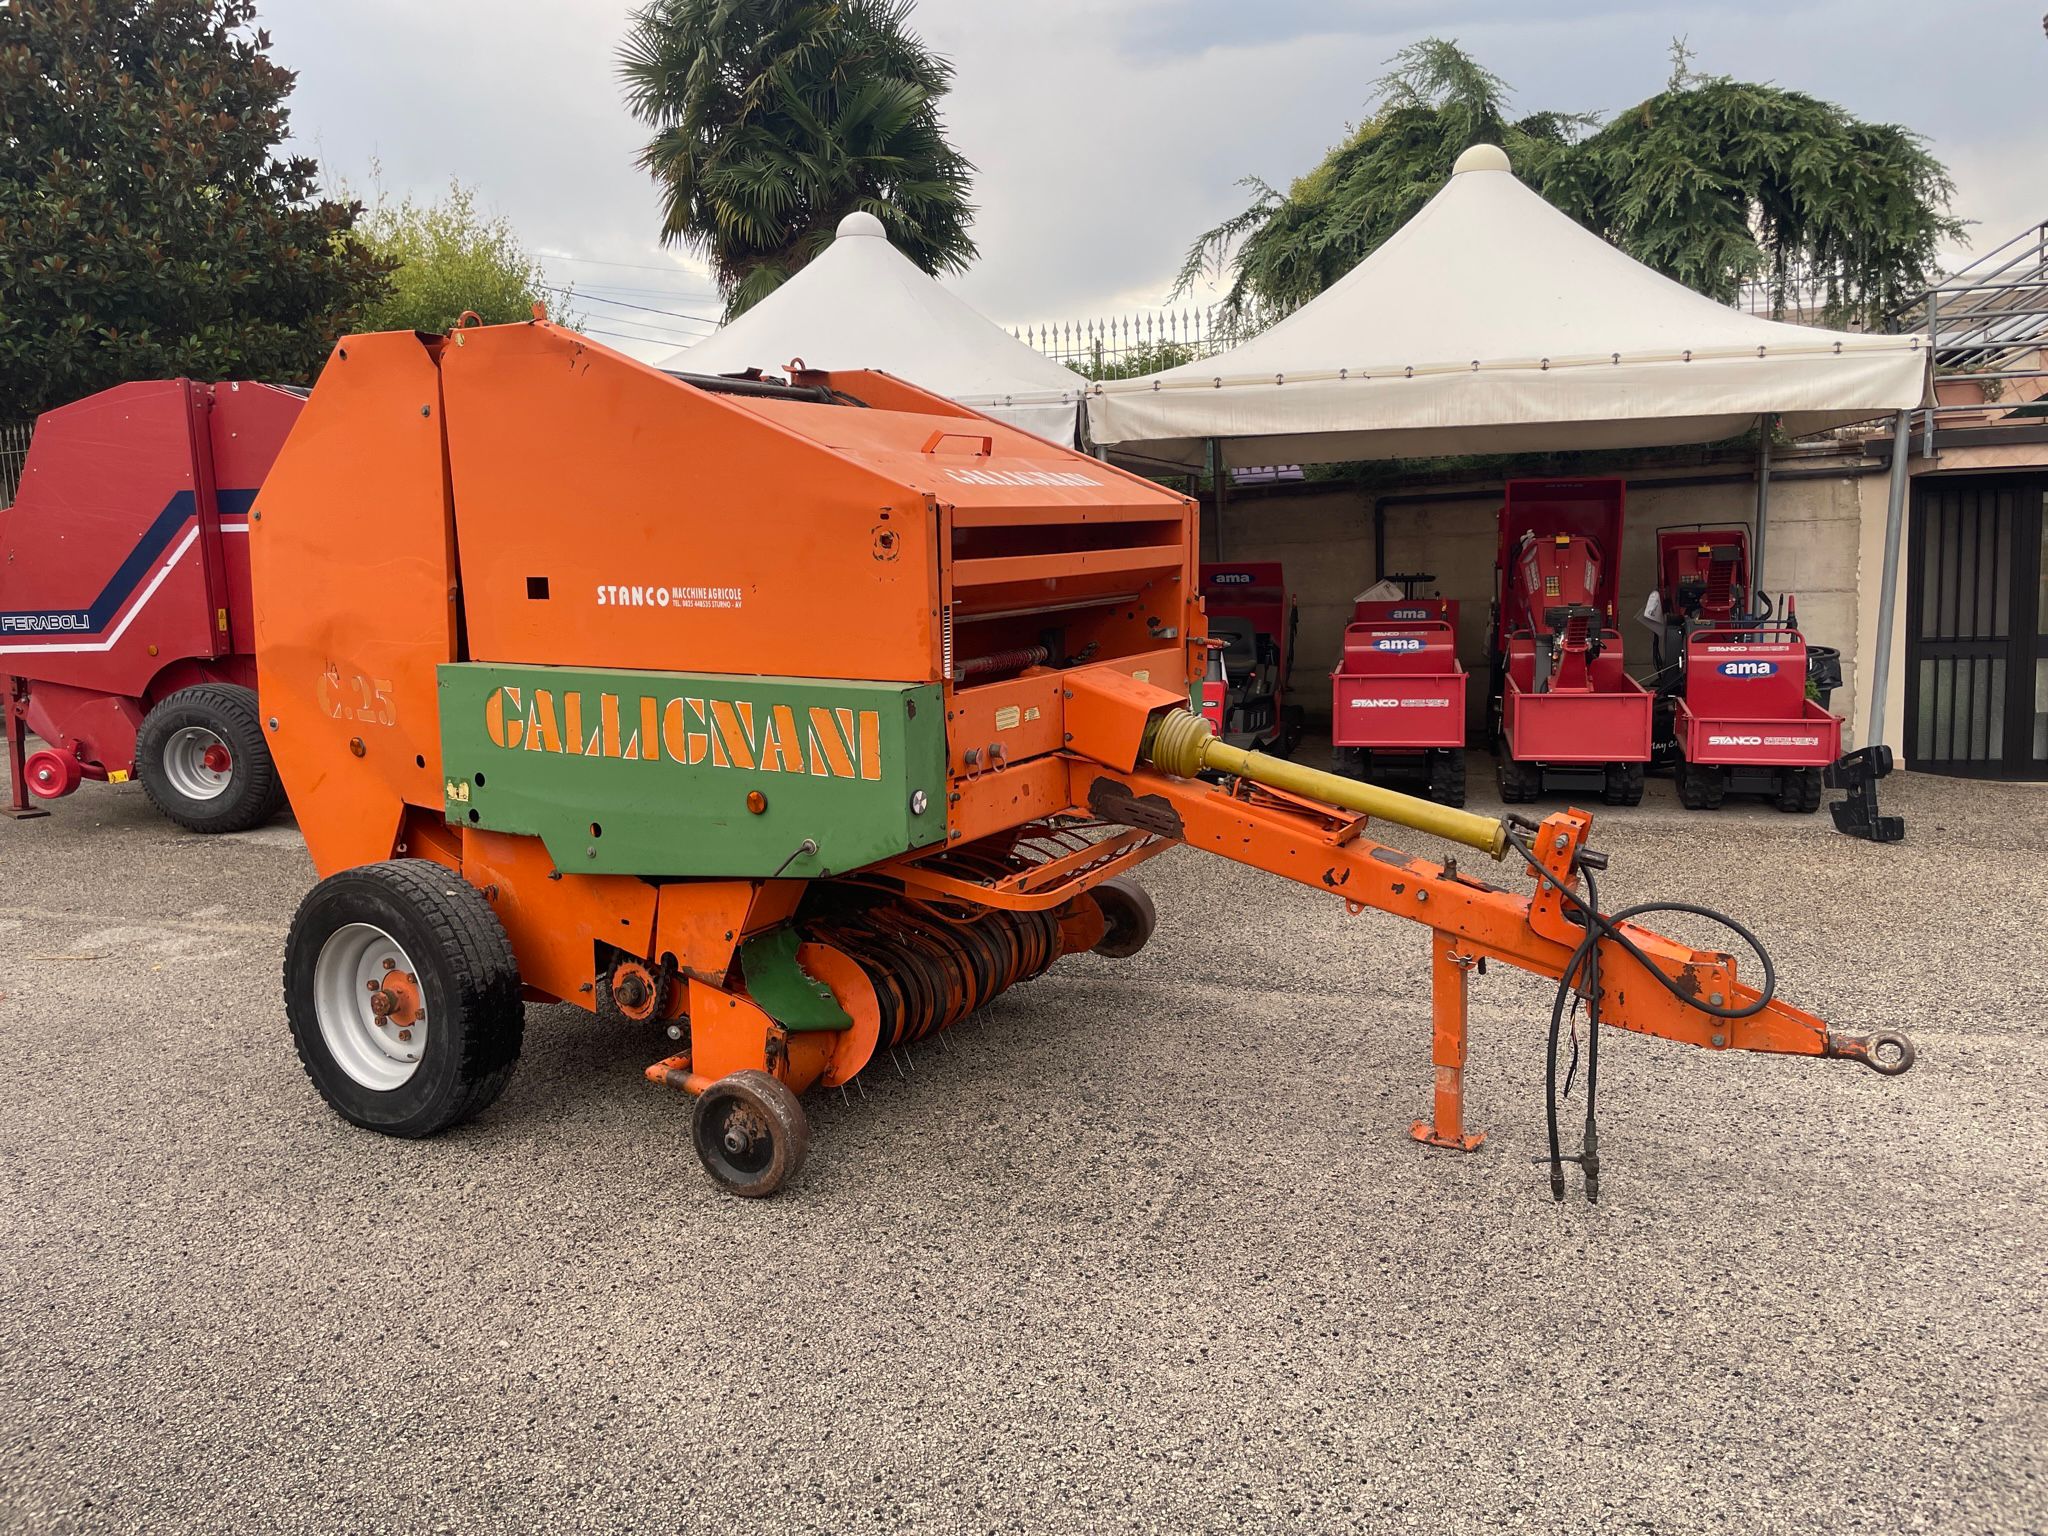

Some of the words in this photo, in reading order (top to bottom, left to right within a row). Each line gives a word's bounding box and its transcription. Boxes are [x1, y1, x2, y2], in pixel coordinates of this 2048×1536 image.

[1216, 574, 1250, 583] ama
[597, 585, 669, 607] STANCO
[672, 587, 707, 600] MACCHINE
[708, 588, 742, 600] AGRICOLE
[1393, 609, 1426, 619] ama
[1, 614, 90, 631] FERABOLI
[1379, 639, 1420, 650] ama
[1725, 662, 1770, 675] ama
[1351, 698, 1399, 708] STANCO
[486, 686, 882, 781] GALLIGNANI
[1708, 735, 1762, 746] STANCO
